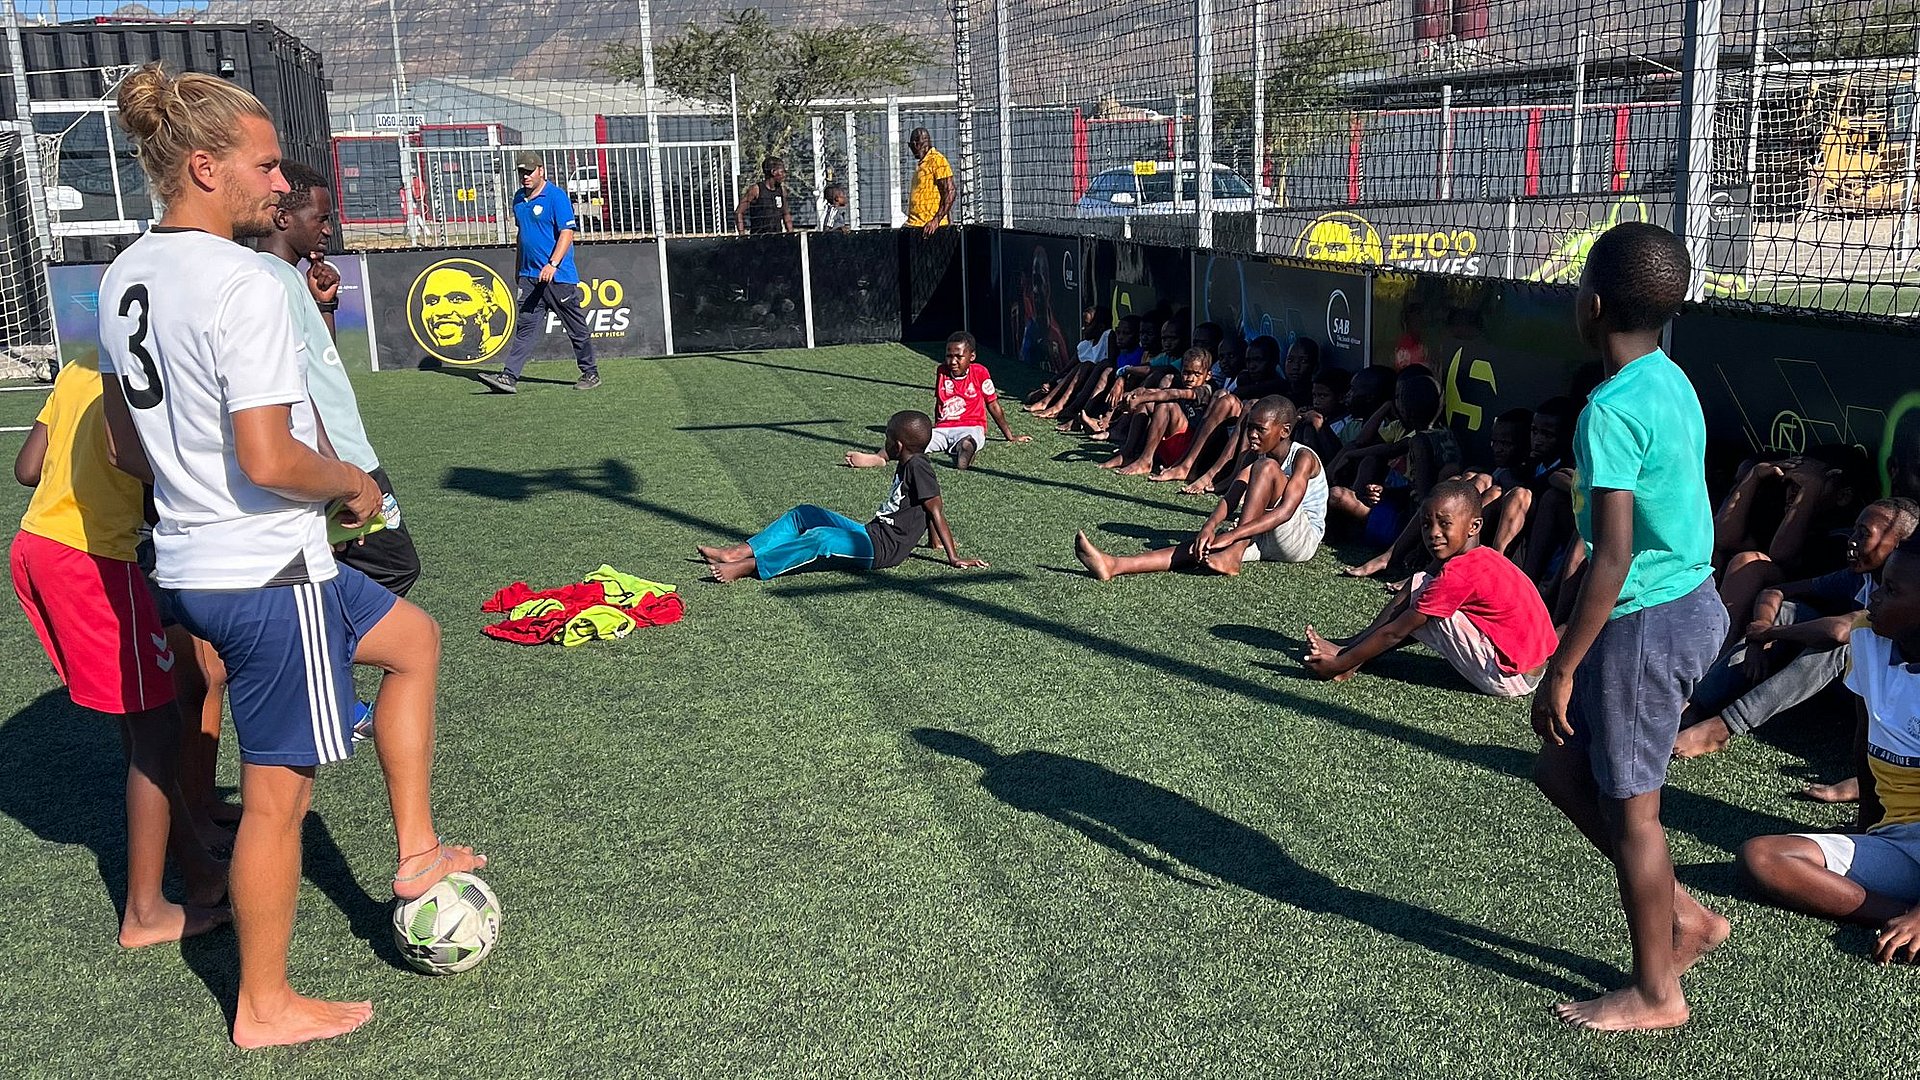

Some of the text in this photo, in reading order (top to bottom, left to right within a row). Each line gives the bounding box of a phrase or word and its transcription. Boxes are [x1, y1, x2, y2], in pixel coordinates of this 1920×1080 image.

[377, 115, 396, 127] LOGO
[1388, 229, 1477, 259] ETO'O
[545, 307, 631, 335] FVES
[1333, 317, 1350, 335] SAB
[118, 283, 164, 410] 3
